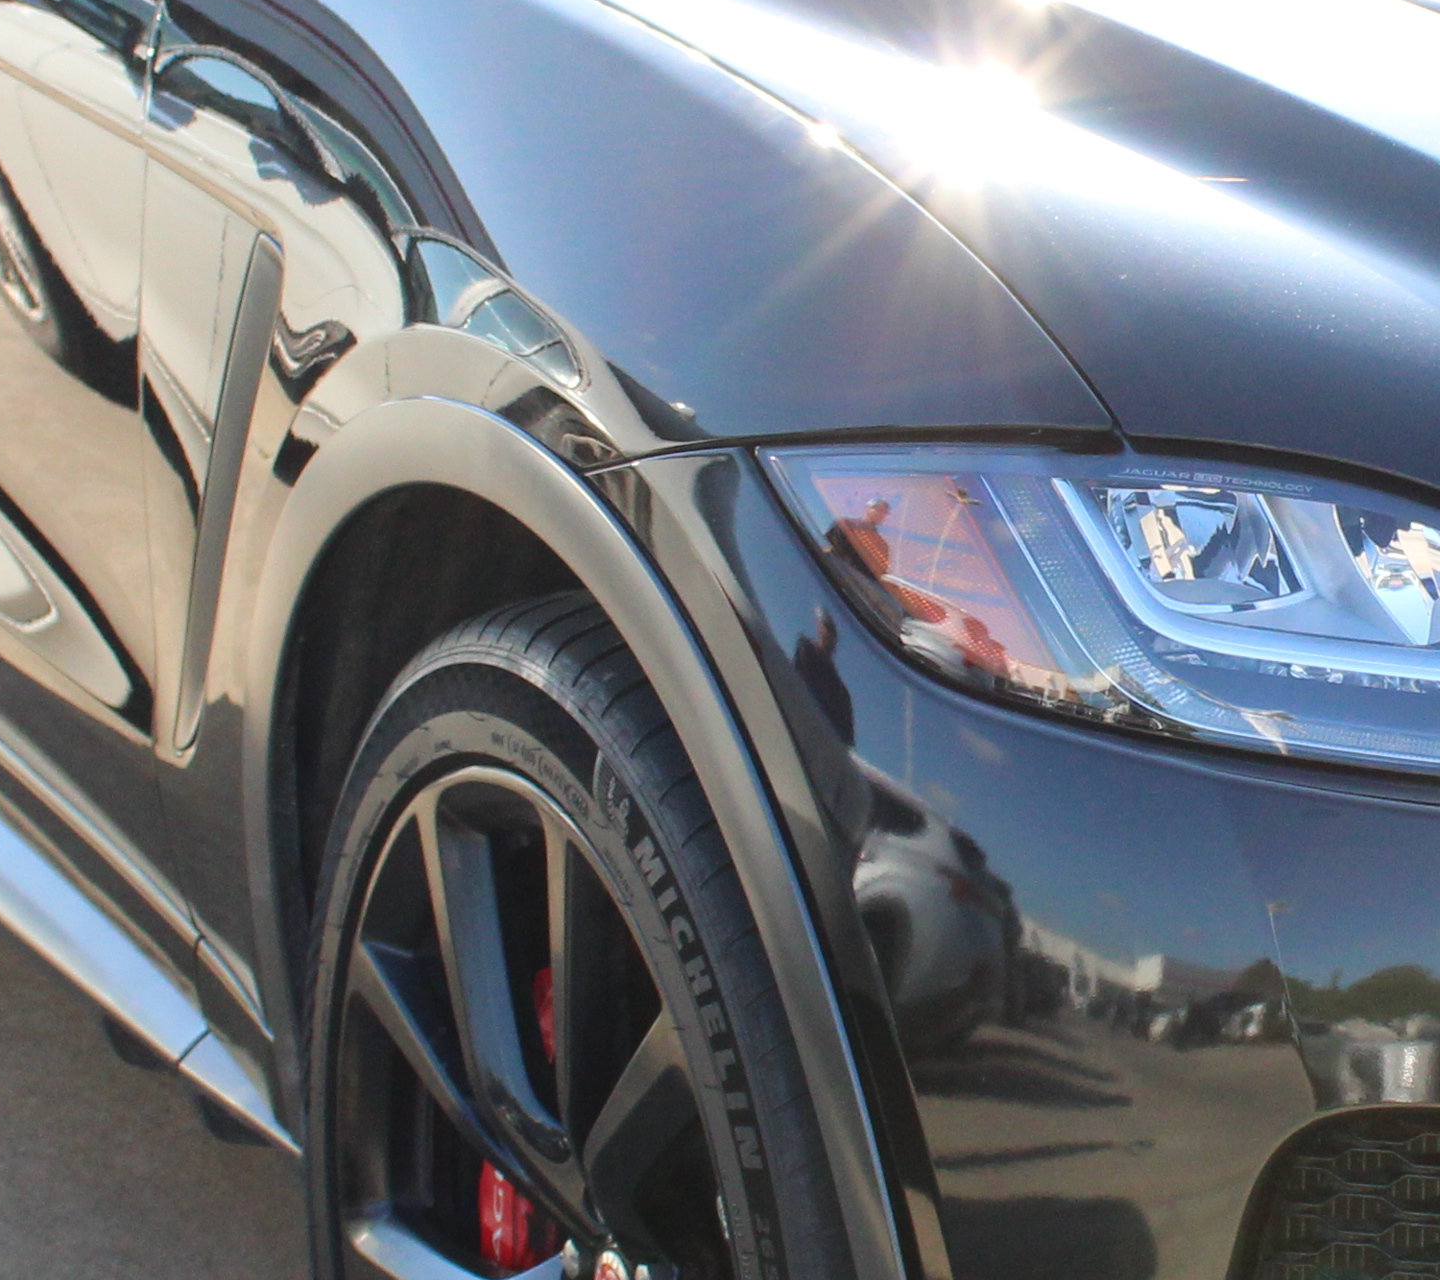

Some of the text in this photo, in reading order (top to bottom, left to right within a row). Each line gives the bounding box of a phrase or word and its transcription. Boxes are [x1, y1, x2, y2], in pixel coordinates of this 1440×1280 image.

[1120, 467, 1191, 480] JAGUAR
[1223, 476, 1314, 493] TECHNOLOGY
[632, 835, 764, 1169] MICHELIN
